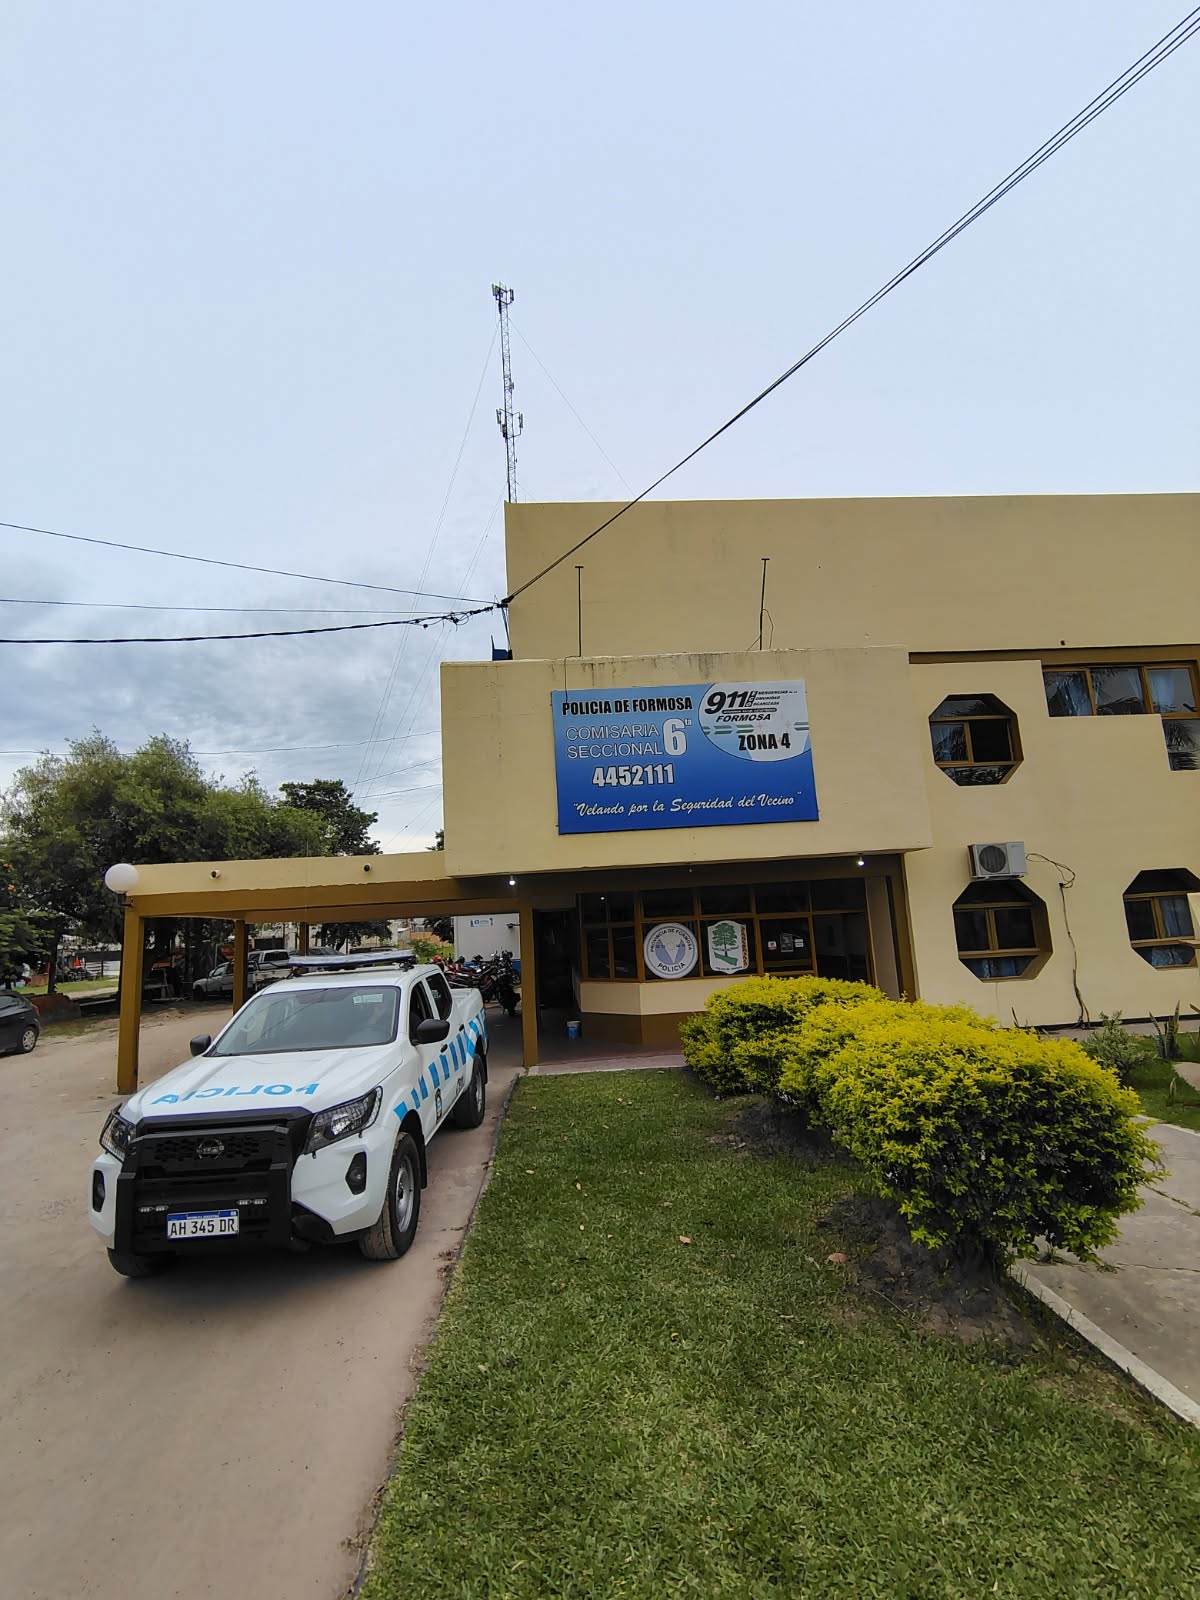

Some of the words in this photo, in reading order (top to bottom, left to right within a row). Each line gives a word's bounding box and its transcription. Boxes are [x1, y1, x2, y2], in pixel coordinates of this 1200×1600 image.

[562, 701, 612, 716] POLICIA
[614, 699, 630, 713] DE
[633, 696, 693, 713] FORMOSA
[704, 691, 748, 714] 911
[716, 713, 771, 723] FORMOSA
[566, 724, 660, 741] COMISARIA
[738, 733, 778, 751] ZONA
[781, 732, 791, 749] 4
[567, 742, 663, 759] SECCIONAL
[592, 763, 674, 787] 4452111
[628, 803, 649, 816] por
[652, 800, 665, 812] la
[670, 798, 734, 814] Seguridad
[738, 795, 755, 808] del
[676, 929, 693, 950] FORMOSA
[657, 962, 685, 972] POLICIA
[170, 1222, 187, 1236] AH
[191, 1220, 215, 1234] 345
[219, 1218, 235, 1233] DR
